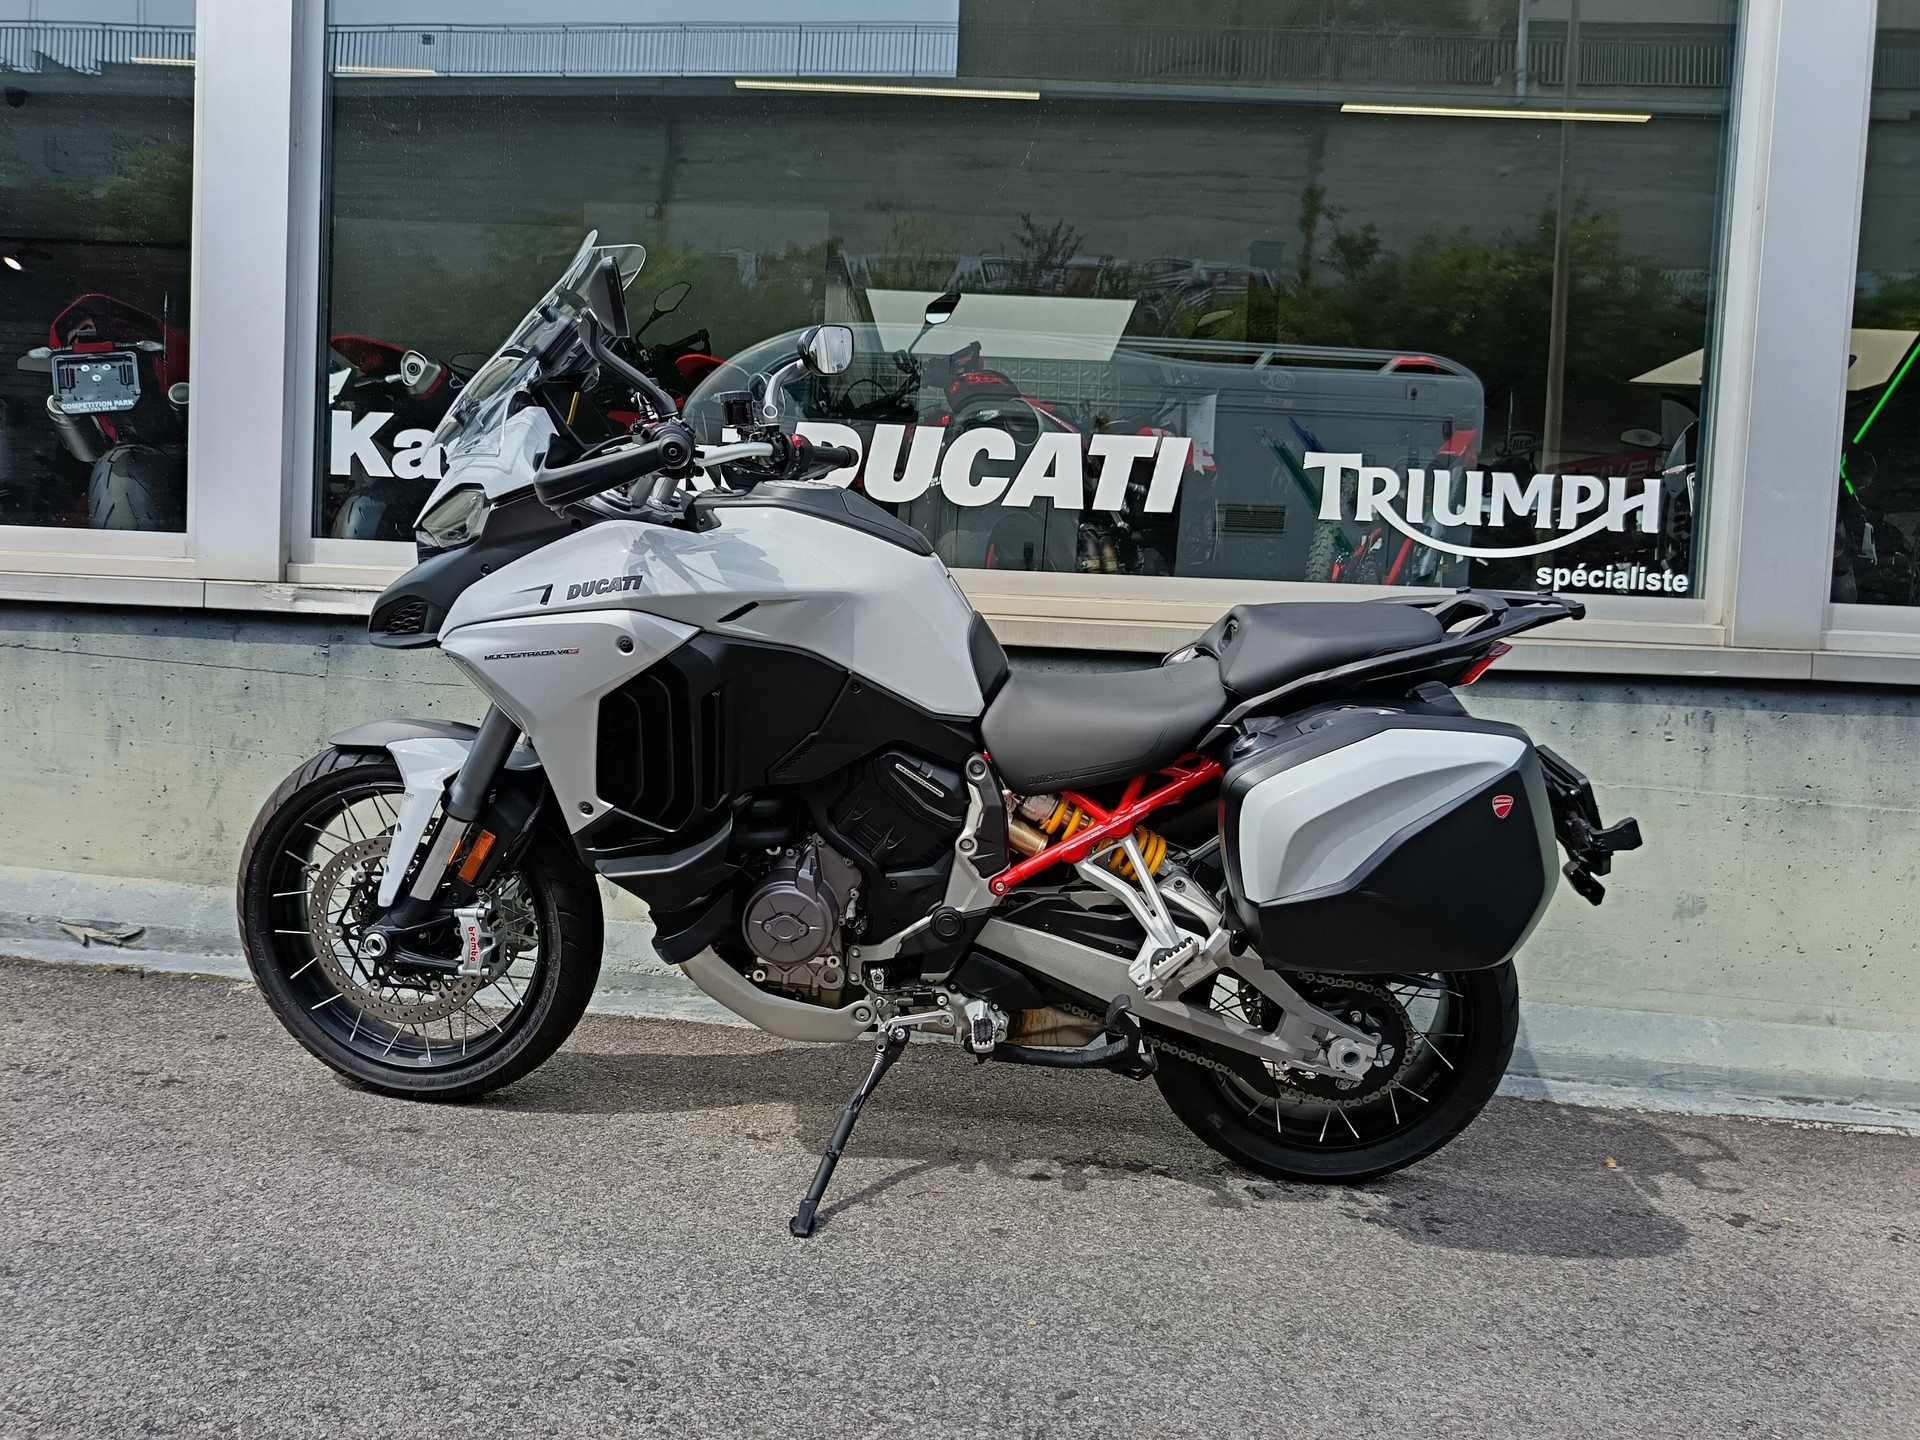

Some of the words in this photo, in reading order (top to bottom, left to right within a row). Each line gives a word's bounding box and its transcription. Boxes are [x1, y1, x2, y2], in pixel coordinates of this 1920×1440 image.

[61, 401, 112, 410] COMPETITION
[795, 422, 1192, 513] DUCATI
[1303, 452, 1662, 559] TRIUMPH
[566, 575, 643, 600] DUCATI
[1536, 564, 1689, 593] spécialiste
[467, 925, 479, 962] brembo
